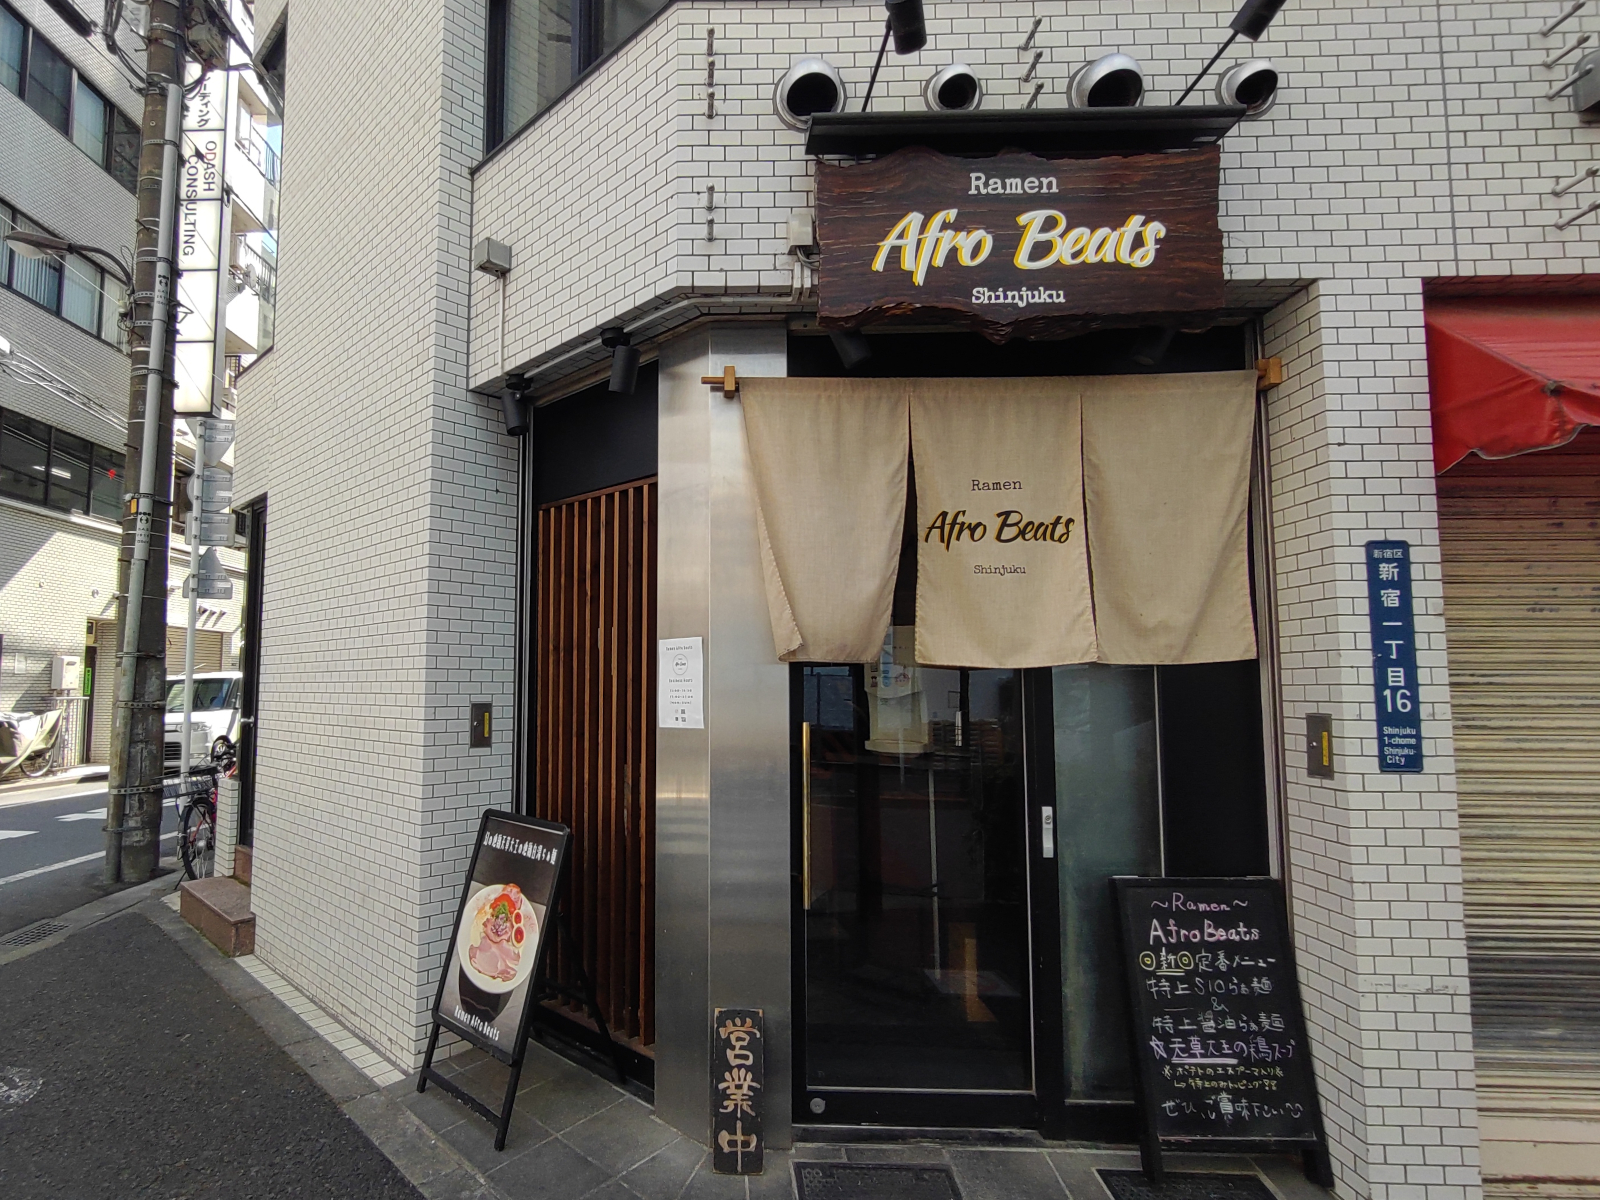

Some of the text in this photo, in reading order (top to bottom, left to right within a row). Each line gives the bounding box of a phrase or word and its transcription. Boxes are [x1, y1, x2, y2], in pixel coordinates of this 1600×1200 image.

[203, 141, 217, 191] ODASH
[968, 172, 1059, 195] Ramen
[183, 154, 199, 256] CONSULTING
[871, 208, 1166, 286] Afro Beats
[971, 287, 1066, 308] Shinjuku
[971, 479, 1023, 492] Ramen
[924, 509, 1075, 552] Afro Beats
[1373, 549, 1404, 559] 新宿区
[973, 564, 1026, 576] Shinjuku
[1383, 726, 1416, 735] Shinjuku
[1383, 736, 1416, 745] 1-chome
[1386, 755, 1405, 766] City
[718, 1017, 761, 1173] 営業中
